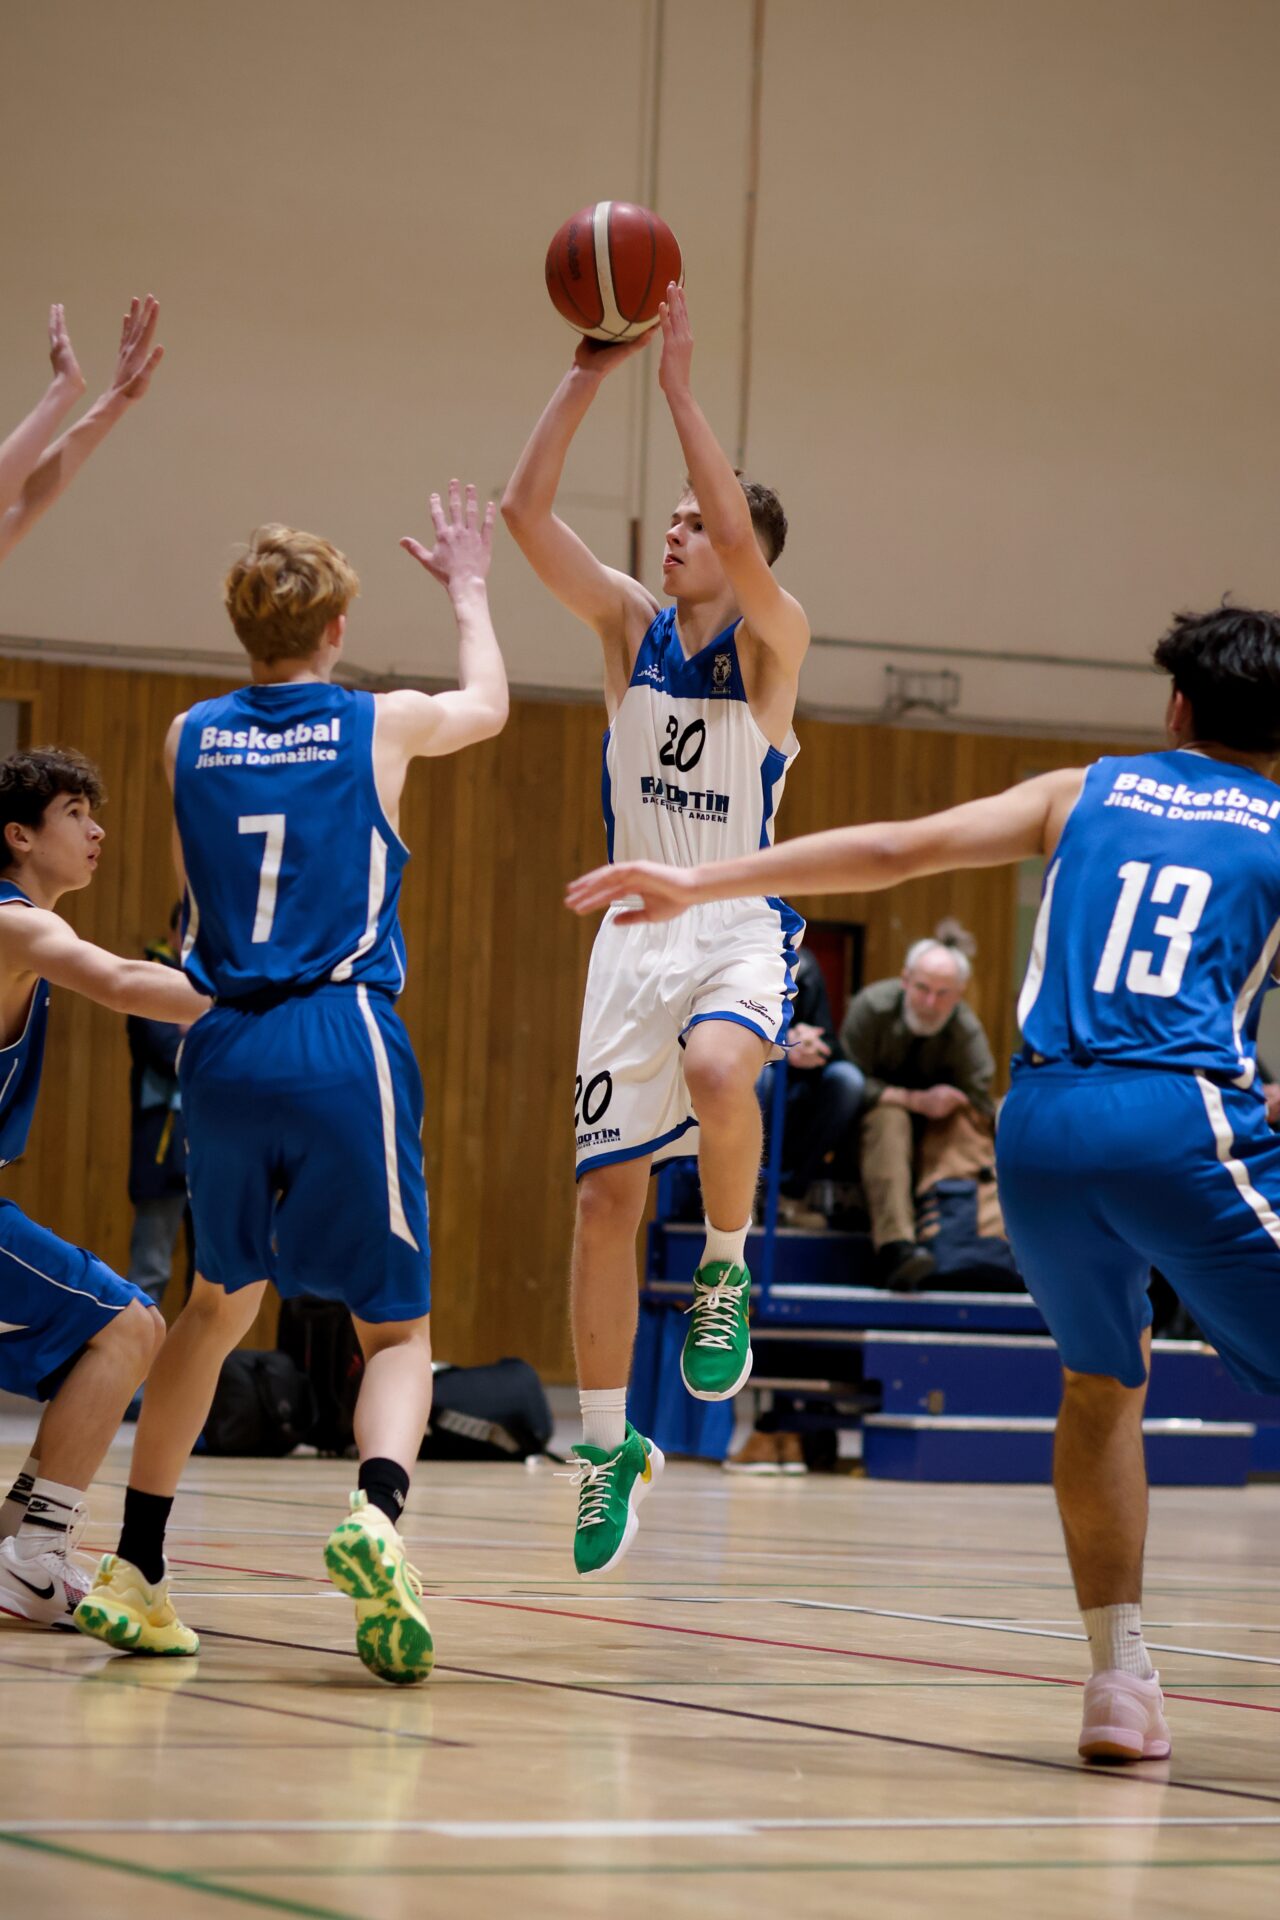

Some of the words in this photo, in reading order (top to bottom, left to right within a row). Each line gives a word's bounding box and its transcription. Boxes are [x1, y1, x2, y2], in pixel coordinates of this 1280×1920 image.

[194, 751, 243, 770] Jiskra
[245, 746, 338, 766] Domažlice
[199, 717, 341, 751] Basketbal
[659, 714, 706, 773] 20
[1103, 791, 1165, 817] Jiskra
[1166, 805, 1272, 835] Domažlice
[1112, 772, 1280, 820] Basketbal
[237, 813, 286, 944] 7
[1092, 860, 1213, 998] 13
